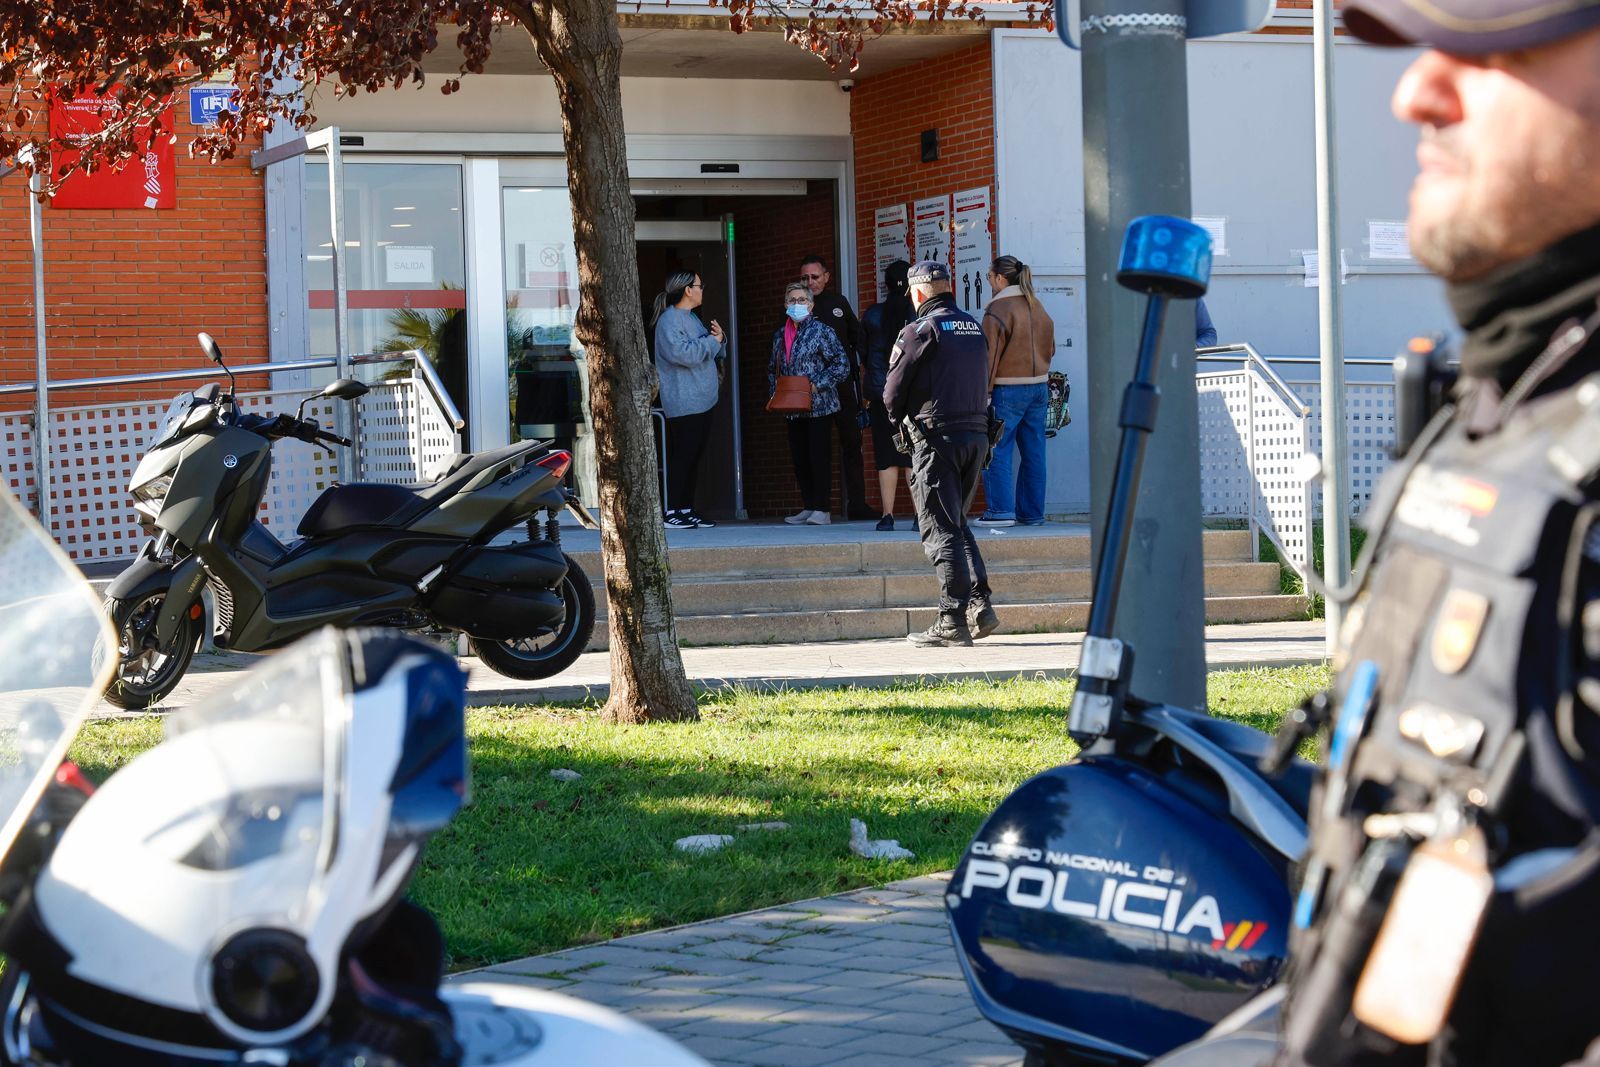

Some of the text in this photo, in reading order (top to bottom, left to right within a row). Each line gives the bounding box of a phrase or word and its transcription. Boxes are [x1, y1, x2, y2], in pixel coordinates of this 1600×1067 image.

[203, 96, 228, 110] IFI
[393, 261, 425, 270] SALIDA
[952, 321, 980, 331] POLICIA
[1045, 850, 1139, 878] NACIONAL
[1142, 865, 1176, 885] DE
